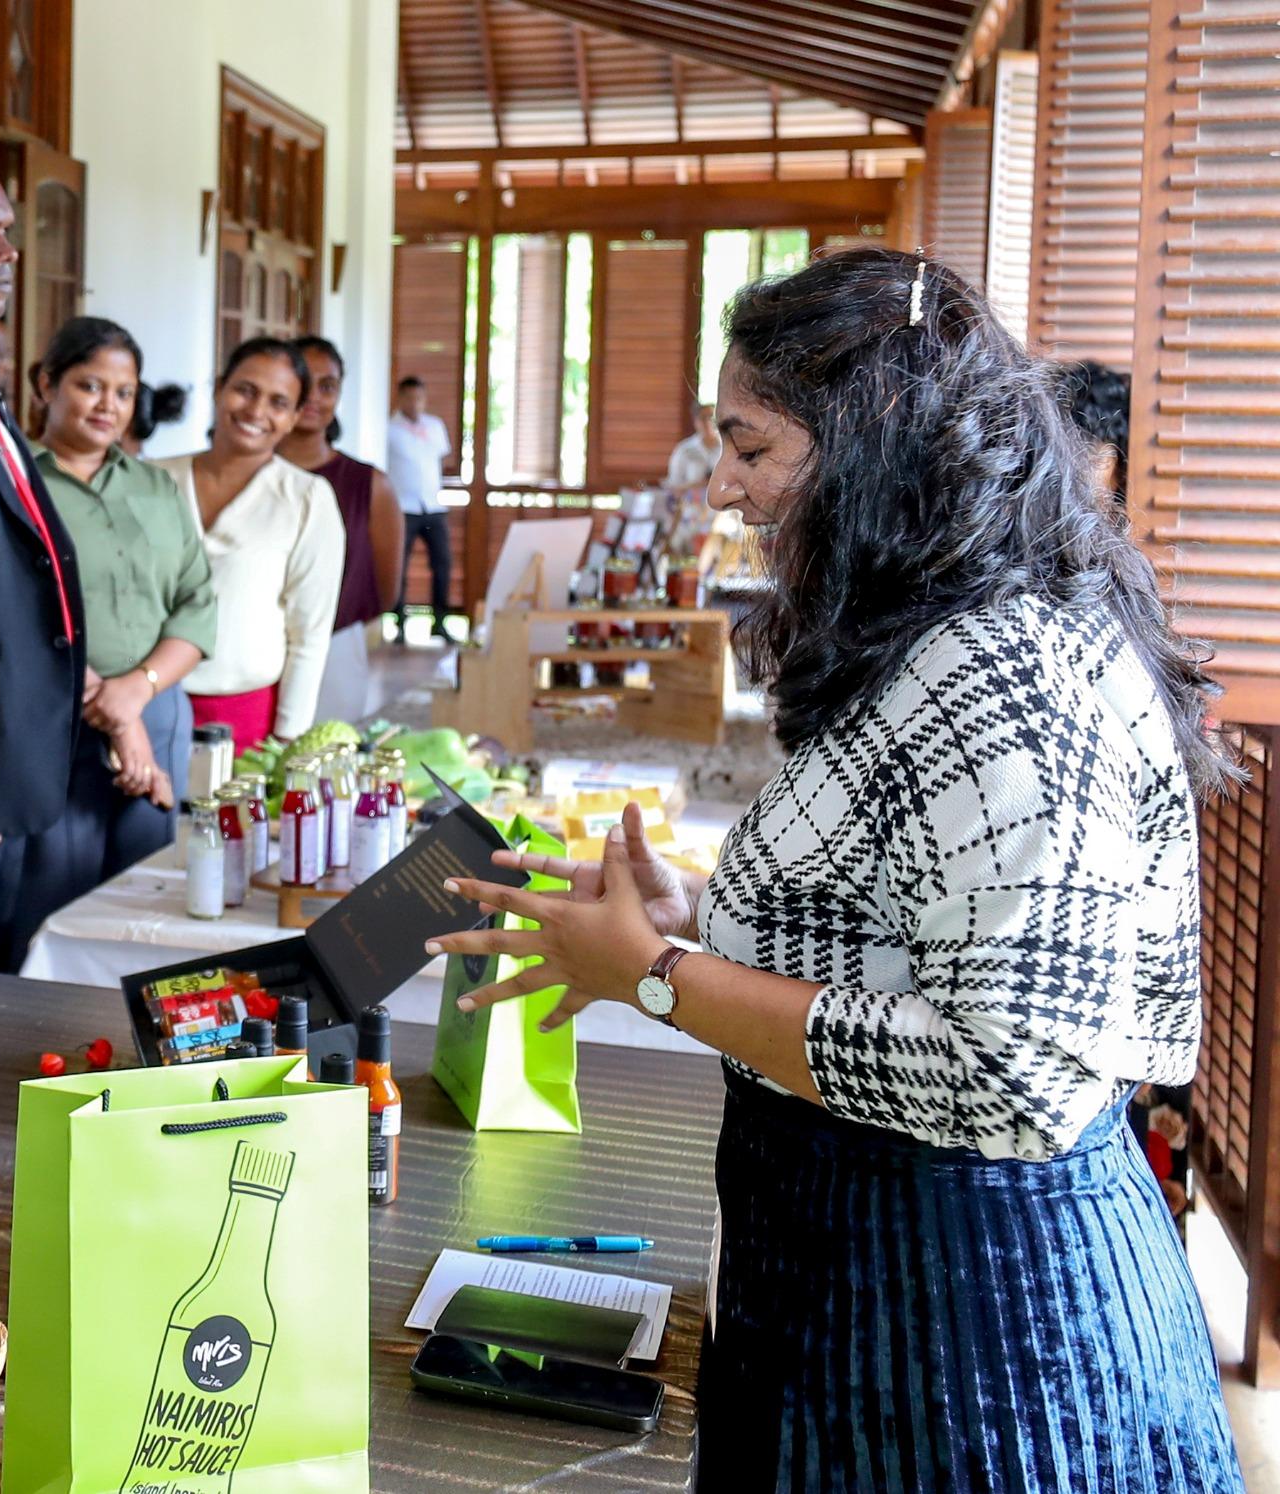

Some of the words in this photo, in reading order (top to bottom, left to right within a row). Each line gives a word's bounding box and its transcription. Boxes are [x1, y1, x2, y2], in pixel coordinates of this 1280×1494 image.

[148, 1388, 254, 1440] NAIMIRIS
[135, 1432, 182, 1470] HOT
[168, 1440, 240, 1476] SAUCE
